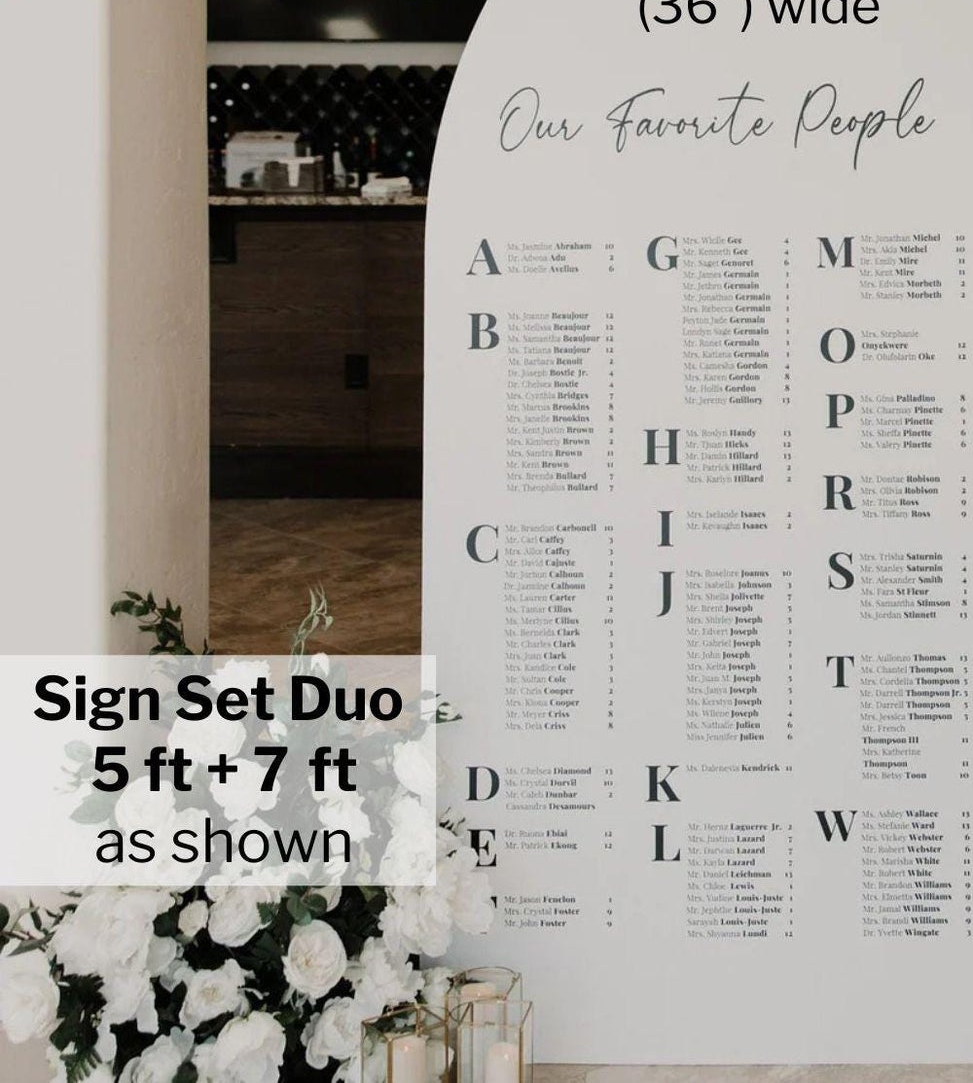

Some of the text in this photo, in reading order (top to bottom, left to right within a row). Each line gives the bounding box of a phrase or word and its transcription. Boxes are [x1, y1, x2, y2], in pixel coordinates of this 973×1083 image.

[500, 78, 935, 170] Our Favorite People
[467, 239, 502, 275] A
[647, 236, 679, 271] G
[818, 237, 854, 268] M
[468, 313, 499, 349] B
[820, 328, 855, 363] O
[728, 373, 761, 381] Gordon
[827, 394, 854, 428] P
[644, 429, 680, 465] H
[823, 475, 856, 510] R
[466, 525, 498, 563] C
[658, 511, 673, 547] I
[737, 580, 773, 590] Johnson
[829, 552, 854, 590] S
[918, 575, 944, 584] Smith
[657, 571, 674, 617] J
[552, 639, 577, 648] Clark
[733, 639, 761, 649] Joseph
[913, 653, 947, 662] Thomas
[827, 656, 854, 688] T
[905, 689, 951, 698] Thompson
[862, 736, 907, 746] Thompson
[466, 767, 499, 801] D
[553, 766, 592, 775] Diamond
[646, 766, 680, 802] K
[815, 811, 857, 842] W
[908, 833, 944, 842] Webster
[911, 821, 935, 830] Ward
[468, 829, 497, 867] E
[653, 825, 680, 861] L
[907, 869, 933, 877] White
[914, 880, 953, 889] Williams
[902, 904, 941, 913] Williams
